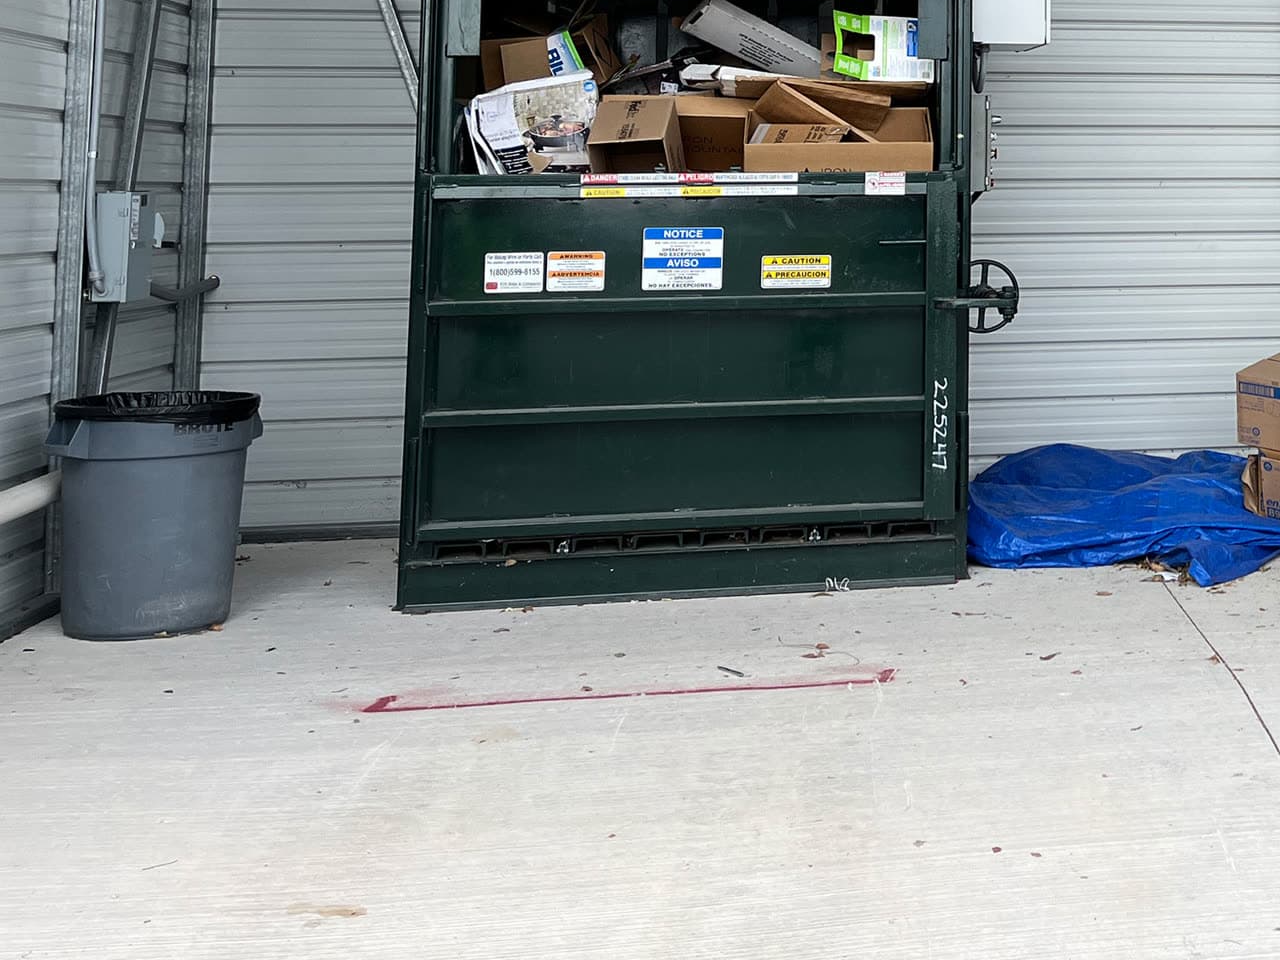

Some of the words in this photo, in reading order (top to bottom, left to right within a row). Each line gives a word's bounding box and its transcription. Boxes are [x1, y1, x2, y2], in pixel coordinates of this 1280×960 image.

[663, 230, 703, 238] NOTICE
[666, 259, 699, 267] AVISO
[932, 377, 948, 470] 225247
